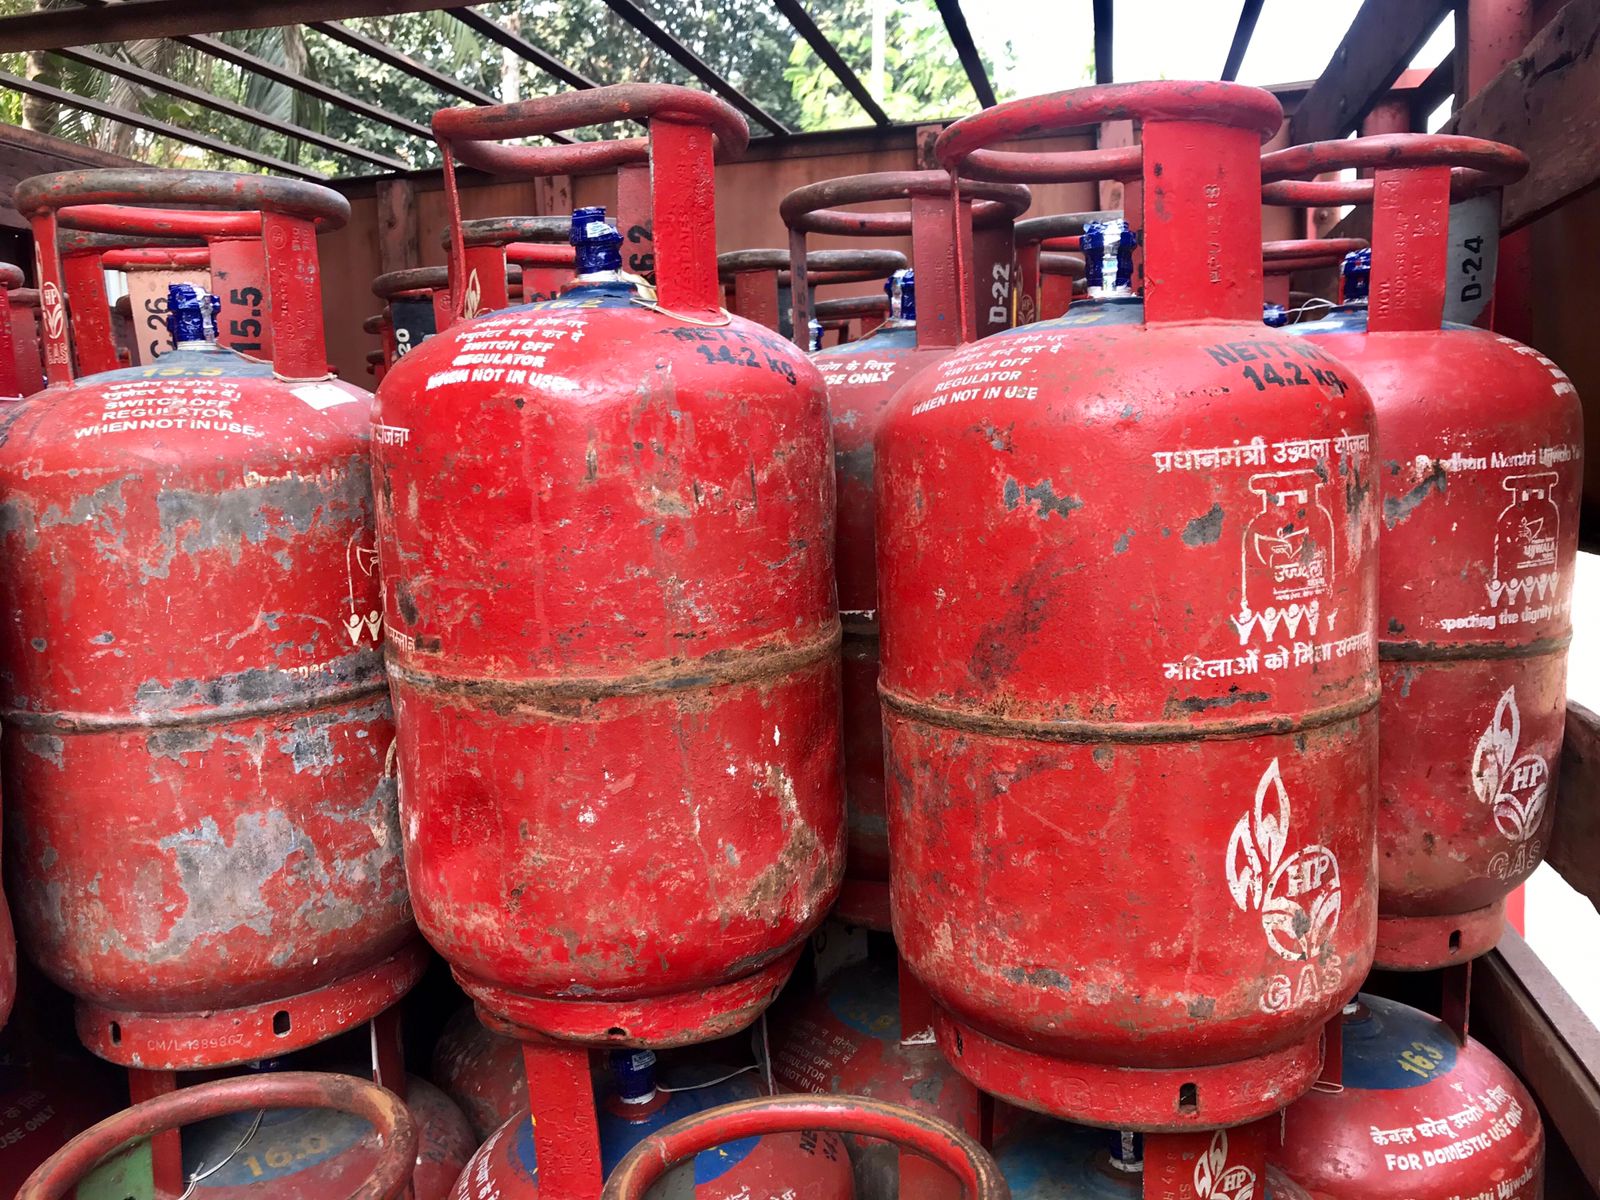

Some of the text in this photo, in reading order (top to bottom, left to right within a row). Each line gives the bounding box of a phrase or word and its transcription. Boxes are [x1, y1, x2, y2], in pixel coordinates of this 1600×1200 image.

[1461, 235, 1484, 302] D-24
[988, 262, 1010, 325] D-22
[230, 286, 263, 353] 15.5
[461, 340, 556, 353] SWITCH OFF
[1204, 341, 1290, 367] NETT
[471, 368, 506, 382] NOT
[505, 369, 528, 385] IN
[847, 371, 895, 385] ONLY
[934, 370, 1022, 393] REGULATOR
[943, 362, 999, 379] SWITCH
[1243, 361, 1310, 391] 14.2
[101, 406, 234, 421] REGULATOR
[104, 398, 232, 411] SWITCH OFF
[911, 385, 1039, 417] WHEN NOT IN USE
[73, 420, 139, 440] WHEN
[139, 418, 187, 430] NOT
[213, 421, 258, 437] USE
[1151, 435, 1268, 474] प्रधानमंत्री
[1498, 608, 1520, 625] the
[1162, 648, 1261, 681] महिलाओं
[1263, 644, 1290, 671] को
[1510, 764, 1544, 793] HP
[1285, 855, 1331, 897] HP
[1258, 953, 1343, 1014] GAS
[813, 1055, 833, 1071] OFF
[800, 1077, 811, 1090] IN
[25, 1105, 56, 1131] ONLY
[1384, 1096, 1525, 1172] FOR DOMESTIC USE ONLY
[1222, 1171, 1248, 1192] HP
